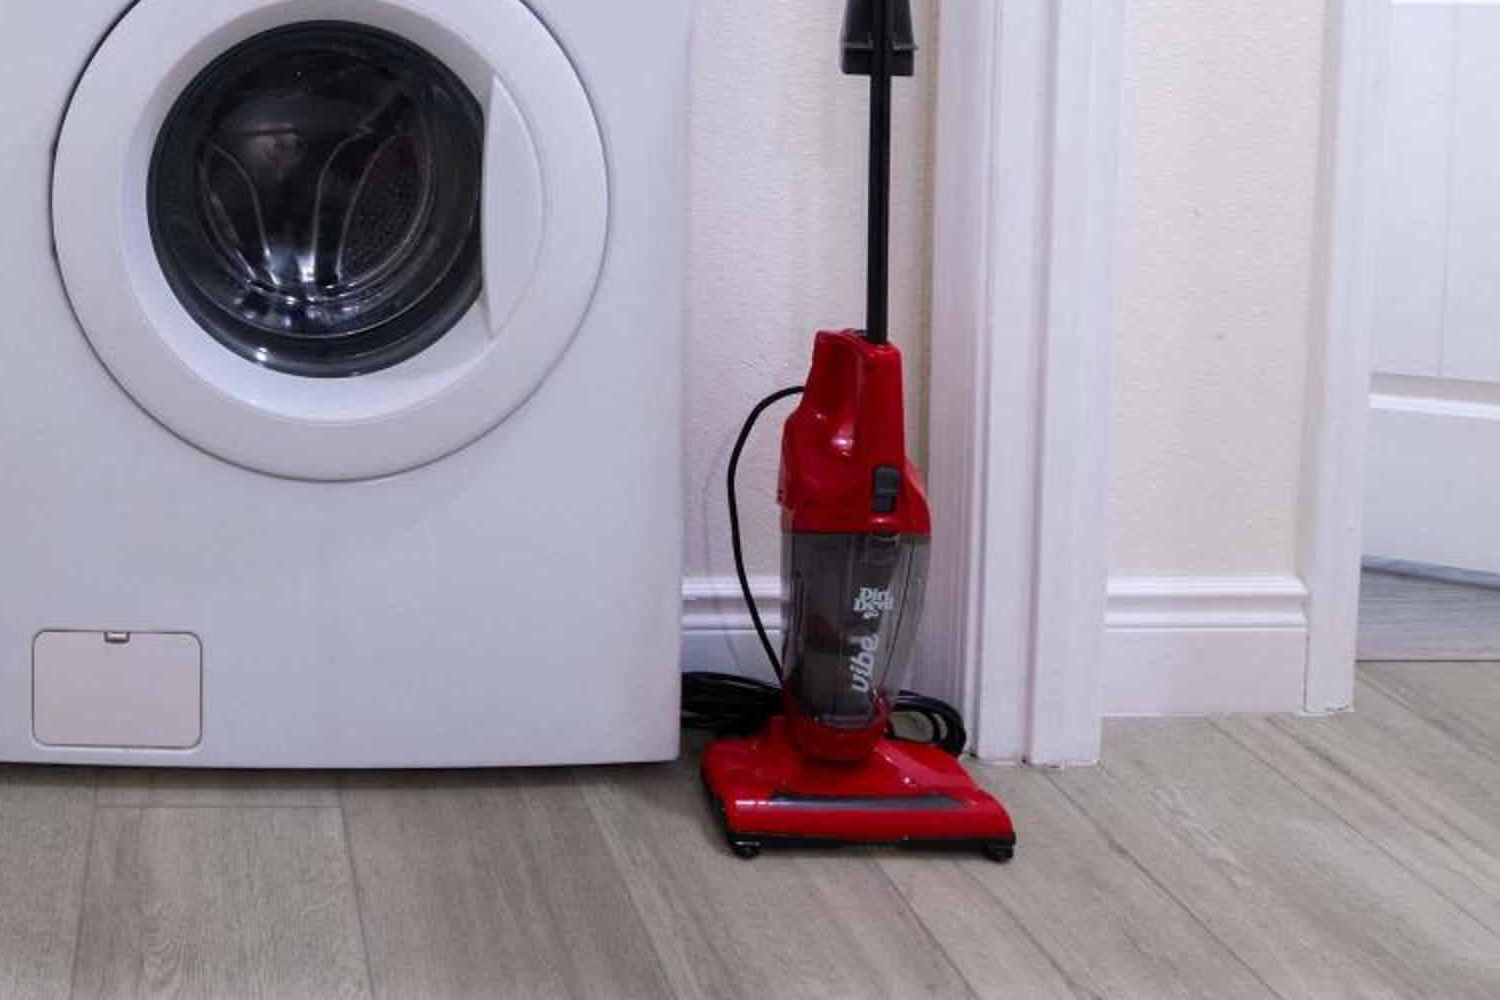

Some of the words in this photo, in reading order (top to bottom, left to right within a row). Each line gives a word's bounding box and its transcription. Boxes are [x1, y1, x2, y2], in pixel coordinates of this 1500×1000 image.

[858, 587, 891, 601] Dirt
[853, 598, 893, 611] Devil
[849, 632, 878, 692] vibe
